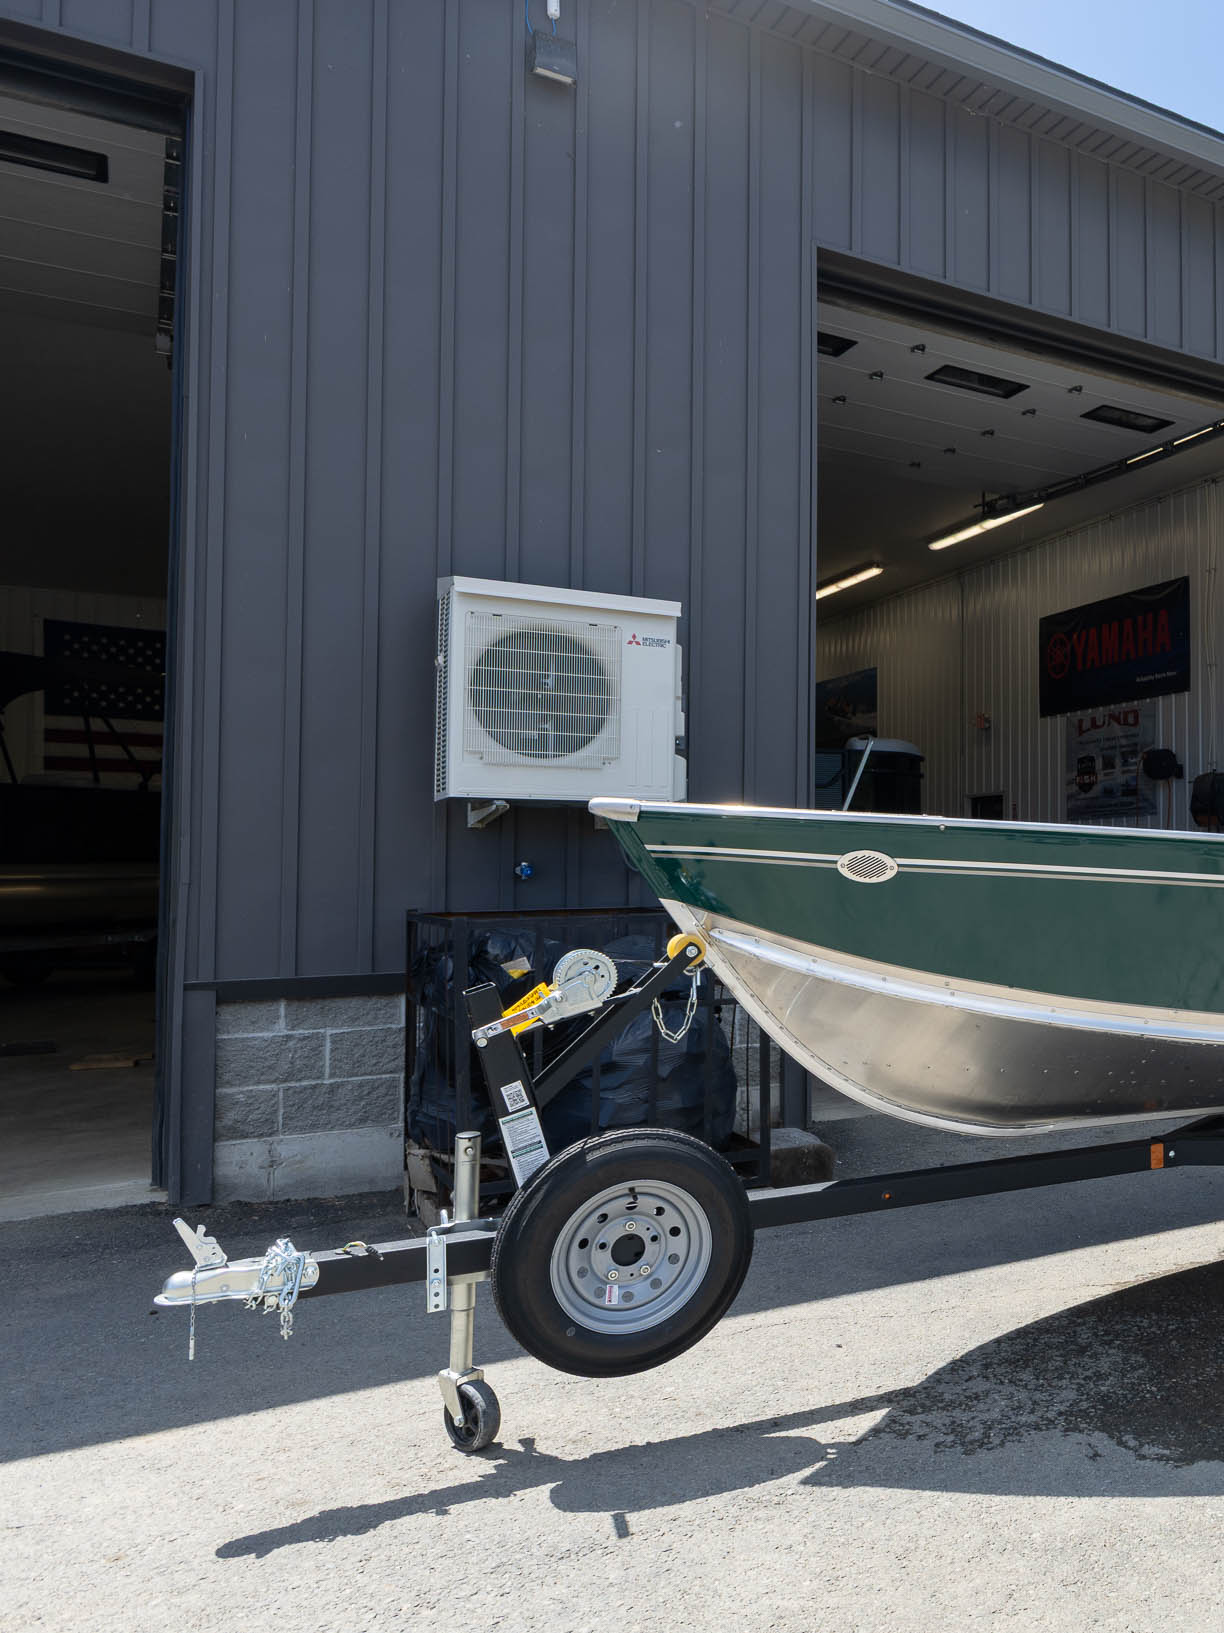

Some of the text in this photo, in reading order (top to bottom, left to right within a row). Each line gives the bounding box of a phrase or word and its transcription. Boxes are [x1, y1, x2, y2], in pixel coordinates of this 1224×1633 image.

[642, 641, 667, 649] ELECTRIC
[1073, 609, 1172, 672] YAMAHA
[1076, 709, 1140, 737] LUND
